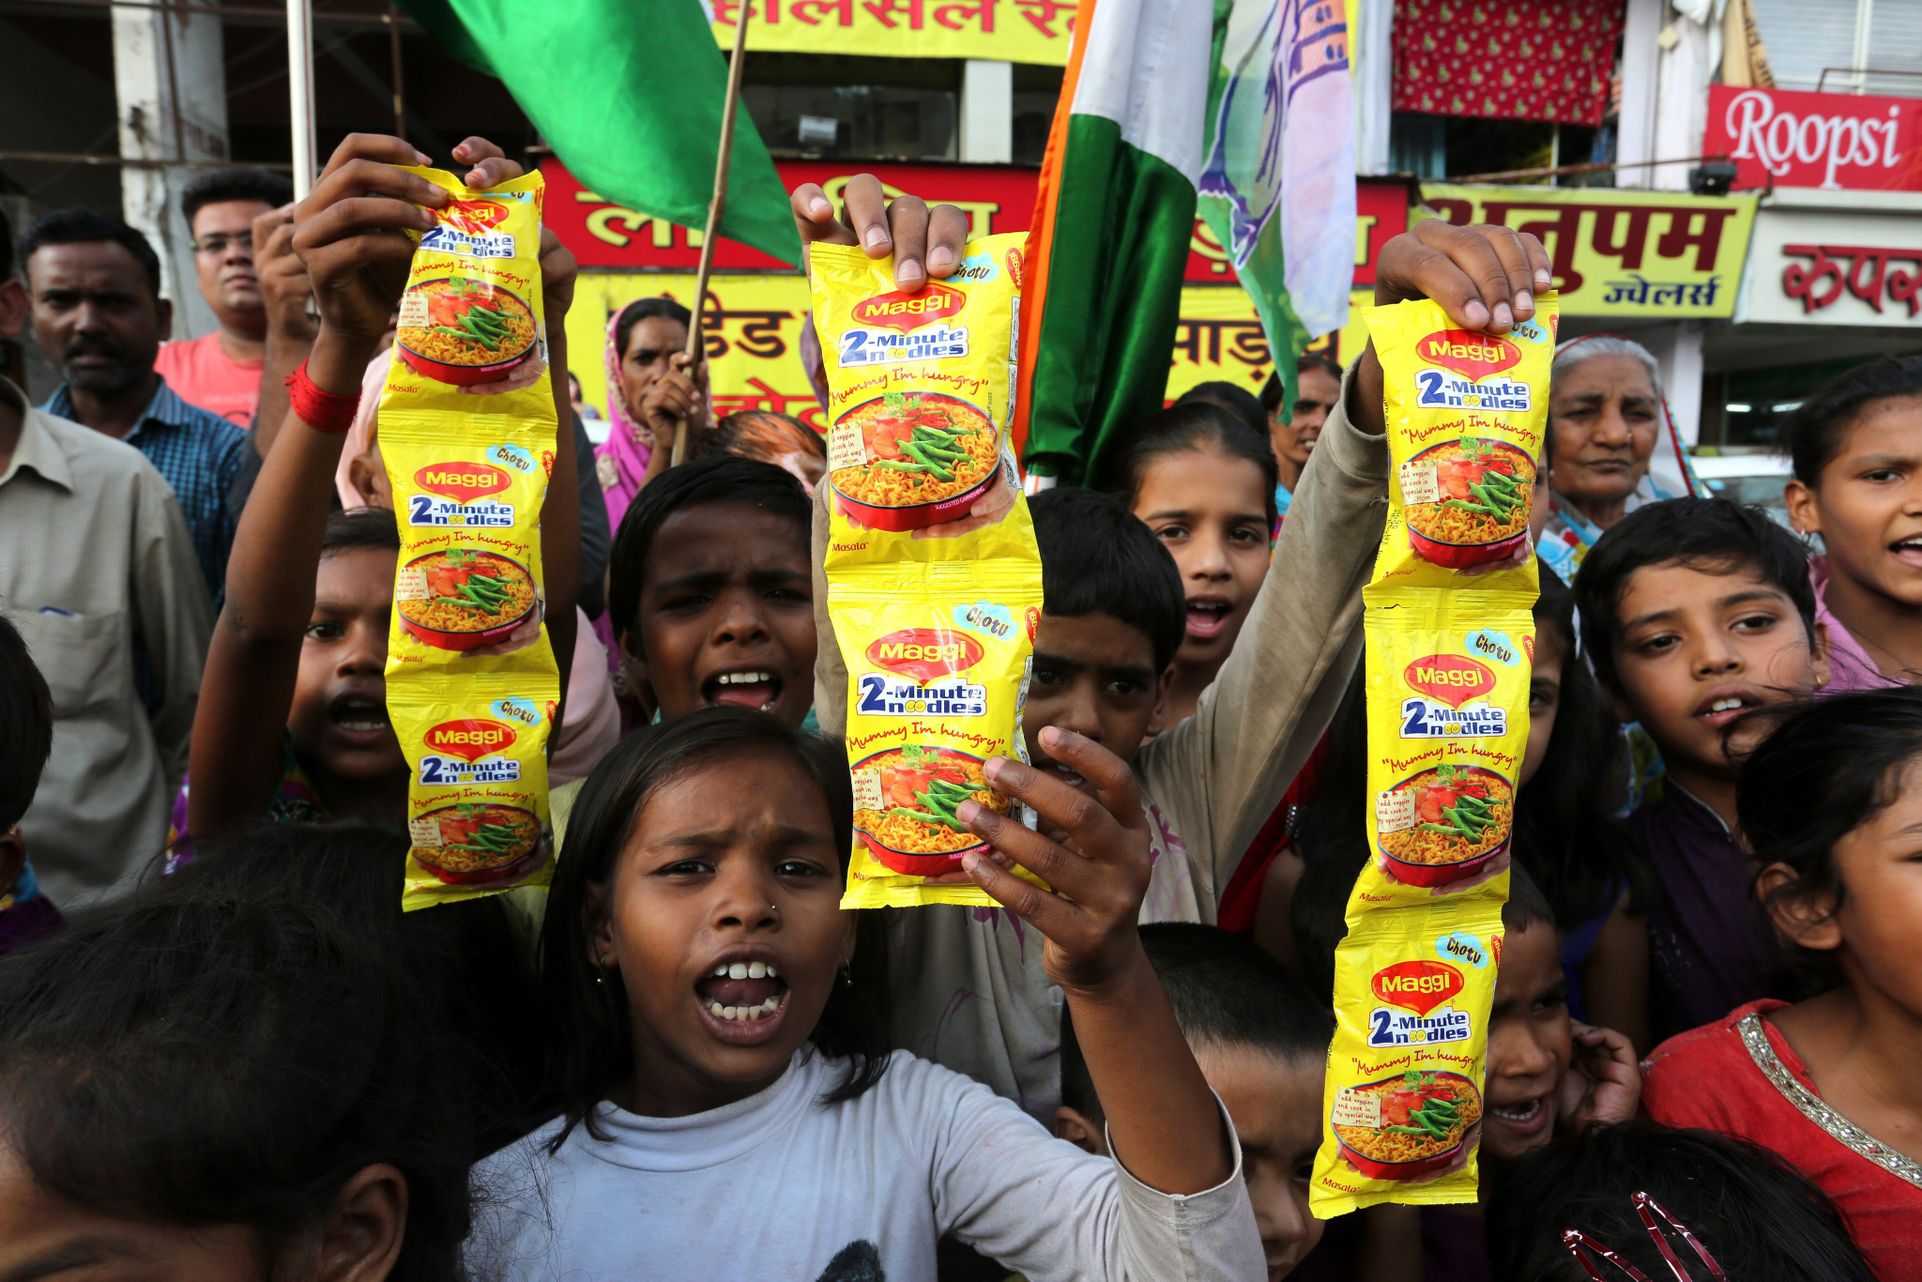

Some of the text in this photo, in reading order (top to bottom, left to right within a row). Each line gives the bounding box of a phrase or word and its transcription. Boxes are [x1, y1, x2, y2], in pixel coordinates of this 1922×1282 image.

[1725, 90, 1901, 189] Roopsi
[865, 294, 951, 318] Maggi
[841, 329, 964, 364] 2-Minute
[869, 342, 965, 362] noodles
[1429, 341, 1506, 363] Maggi
[892, 367, 917, 381] I'm
[1419, 371, 1527, 404] 2-Minute
[1449, 396, 1527, 409] noodles
[1468, 415, 1490, 427] I'm
[496, 447, 531, 471] Chotu
[426, 472, 498, 488] Maggi
[411, 497, 512, 524] 2-Minute
[434, 514, 512, 526] noodles
[453, 531, 474, 541] I'm
[966, 607, 1009, 638] Chotu
[879, 641, 966, 663] Maggi
[1475, 633, 1511, 663] Chotu
[1416, 667, 1483, 687] Maggi
[862, 677, 982, 712] 2-Minute
[501, 701, 535, 723] Chotu
[888, 700, 982, 714] noodles
[1404, 700, 1504, 735] 2-Minute
[435, 729, 503, 744] Maggi
[911, 722, 936, 735] I'm
[1430, 722, 1504, 736] noodles
[1447, 743, 1468, 756] I'm
[423, 757, 517, 783] 2-Minute
[445, 771, 517, 783] noodles
[463, 788, 483, 798] I'm
[1447, 937, 1482, 965] Chotu
[1381, 971, 1451, 993] Maggi
[1371, 1010, 1467, 1045] 2-Minute
[1395, 1027, 1468, 1045] noodles
[1414, 1049, 1434, 1062] I'm
[1322, 1178, 1356, 1192] Masala
